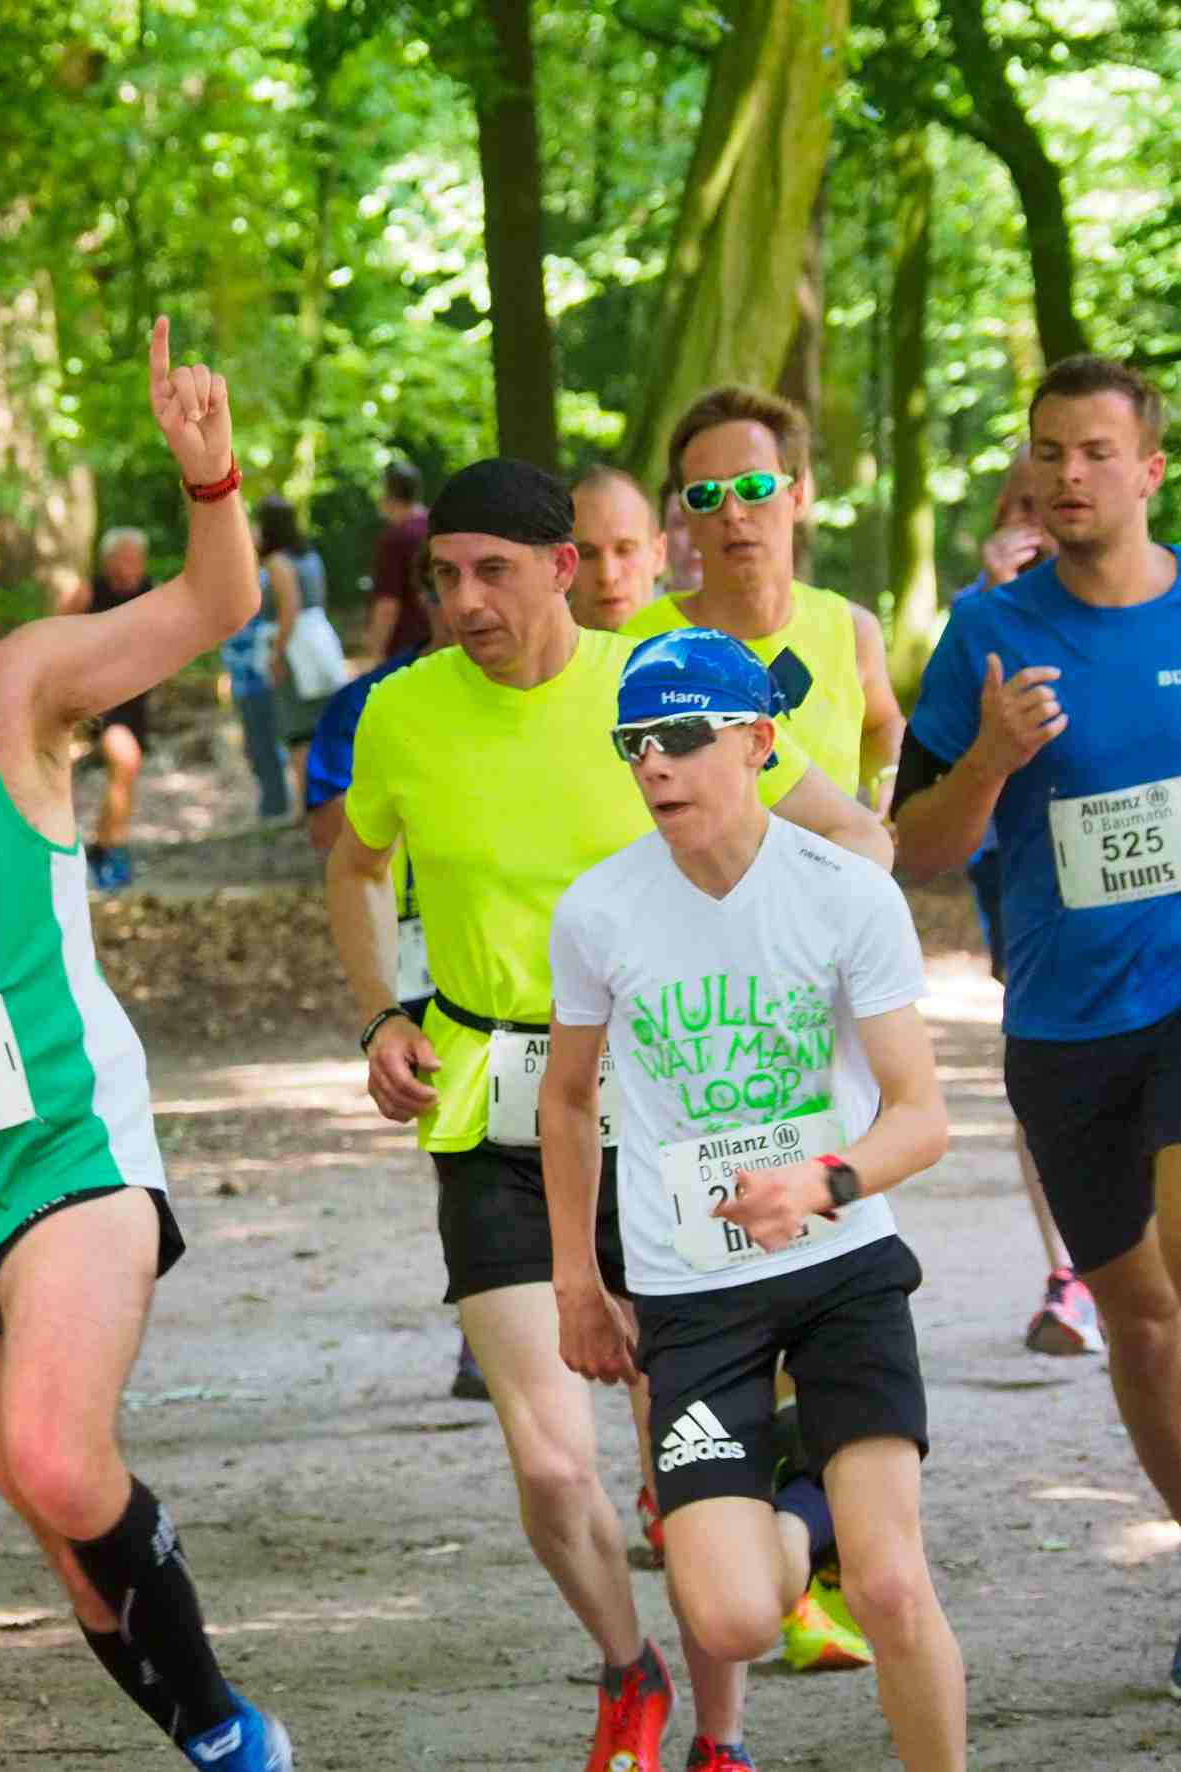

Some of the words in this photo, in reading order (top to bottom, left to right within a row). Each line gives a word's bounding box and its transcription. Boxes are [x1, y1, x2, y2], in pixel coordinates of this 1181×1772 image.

[661, 690, 711, 709] Harry
[1081, 797, 1140, 817] Allianz
[1102, 826, 1164, 862] 525
[1102, 862, 1176, 893] bruns
[632, 1035, 712, 1082] WAT
[698, 1135, 769, 1163] Allianz
[659, 1438, 746, 1472] adidas
